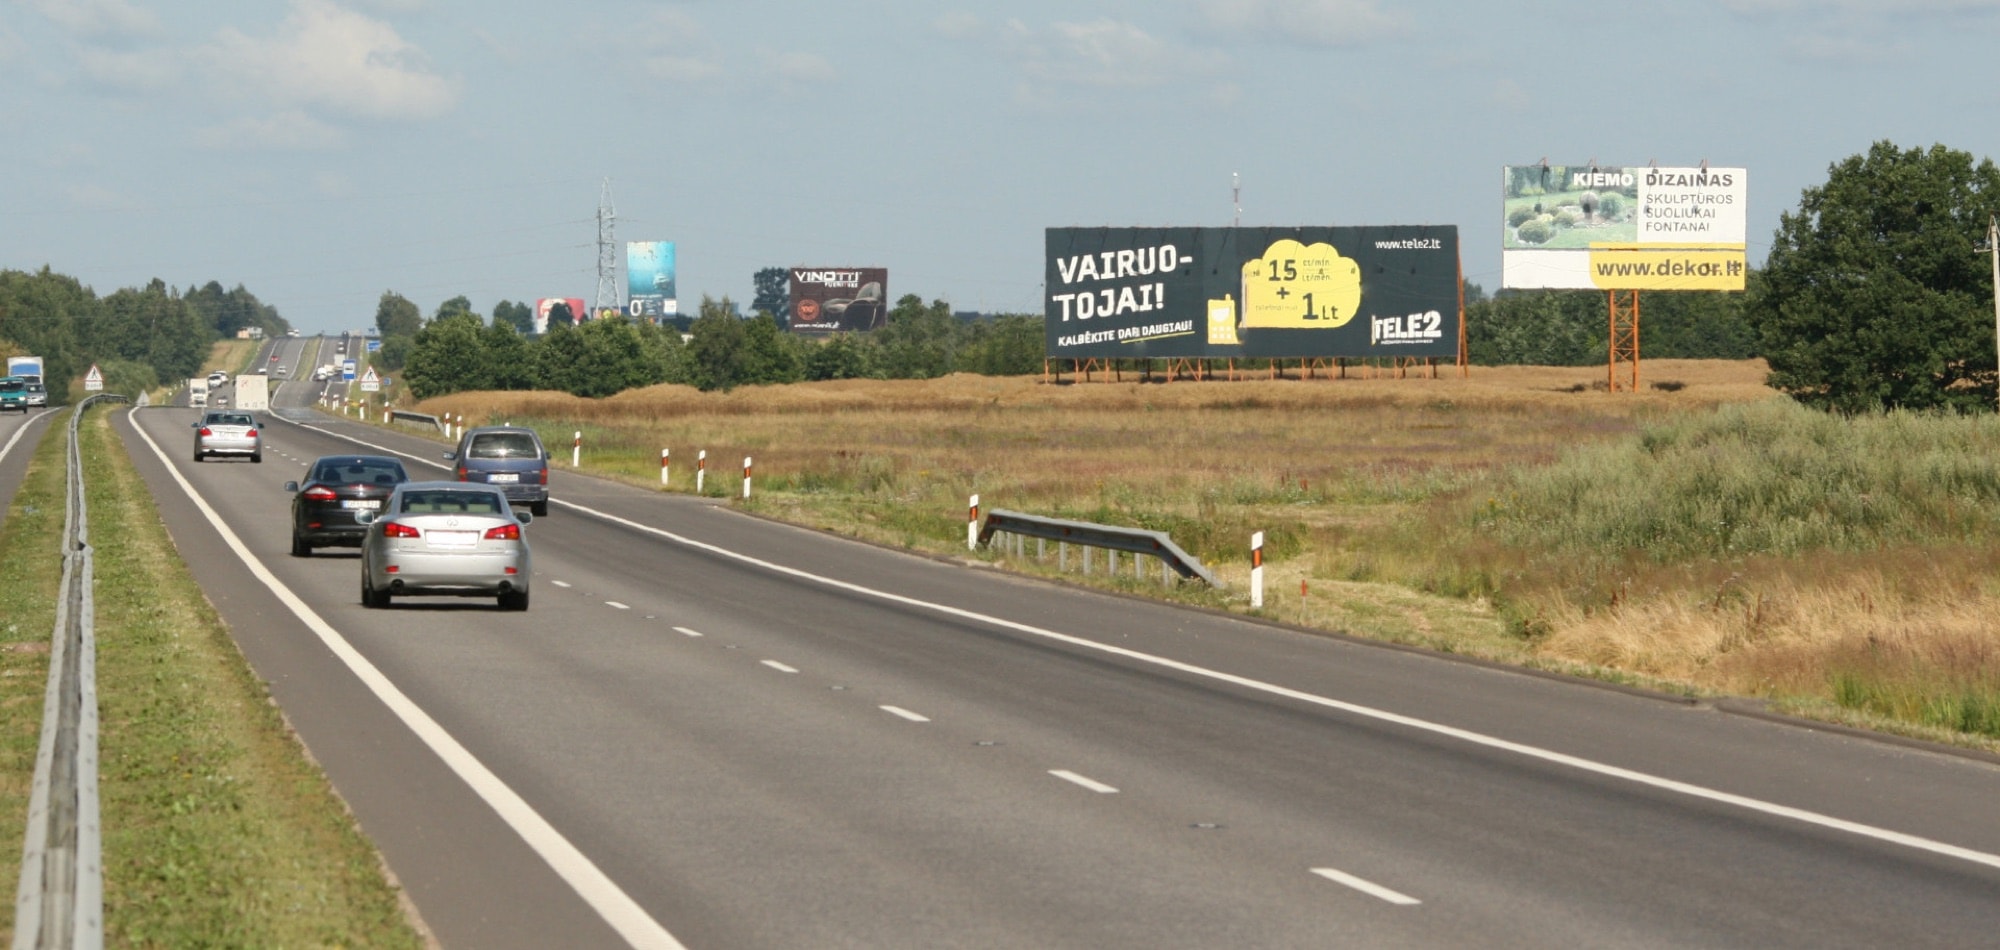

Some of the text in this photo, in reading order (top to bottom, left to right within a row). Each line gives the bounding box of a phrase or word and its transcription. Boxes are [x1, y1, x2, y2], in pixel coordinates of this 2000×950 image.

[1573, 172, 1633, 187] KIEMO
[1645, 173, 1733, 187] DIZAINAS
[1645, 192, 1733, 204] SKULPTŪROS
[1645, 207, 1716, 218] SUOLIUKAI
[1645, 221, 1710, 232] FONTANAI
[1375, 238, 1441, 249] www.tele2.lt
[1056, 244, 1193, 283] VAIRUO-
[1268, 259, 1298, 282] 15
[1597, 259, 1740, 277] www.dekor.lt
[794, 271, 859, 282] VINOTTI
[1053, 282, 1164, 322] TOJAI!
[1374, 310, 1442, 339] TELE2
[1058, 320, 1193, 347] KALBĖKITE DAR DAUGIAU!
